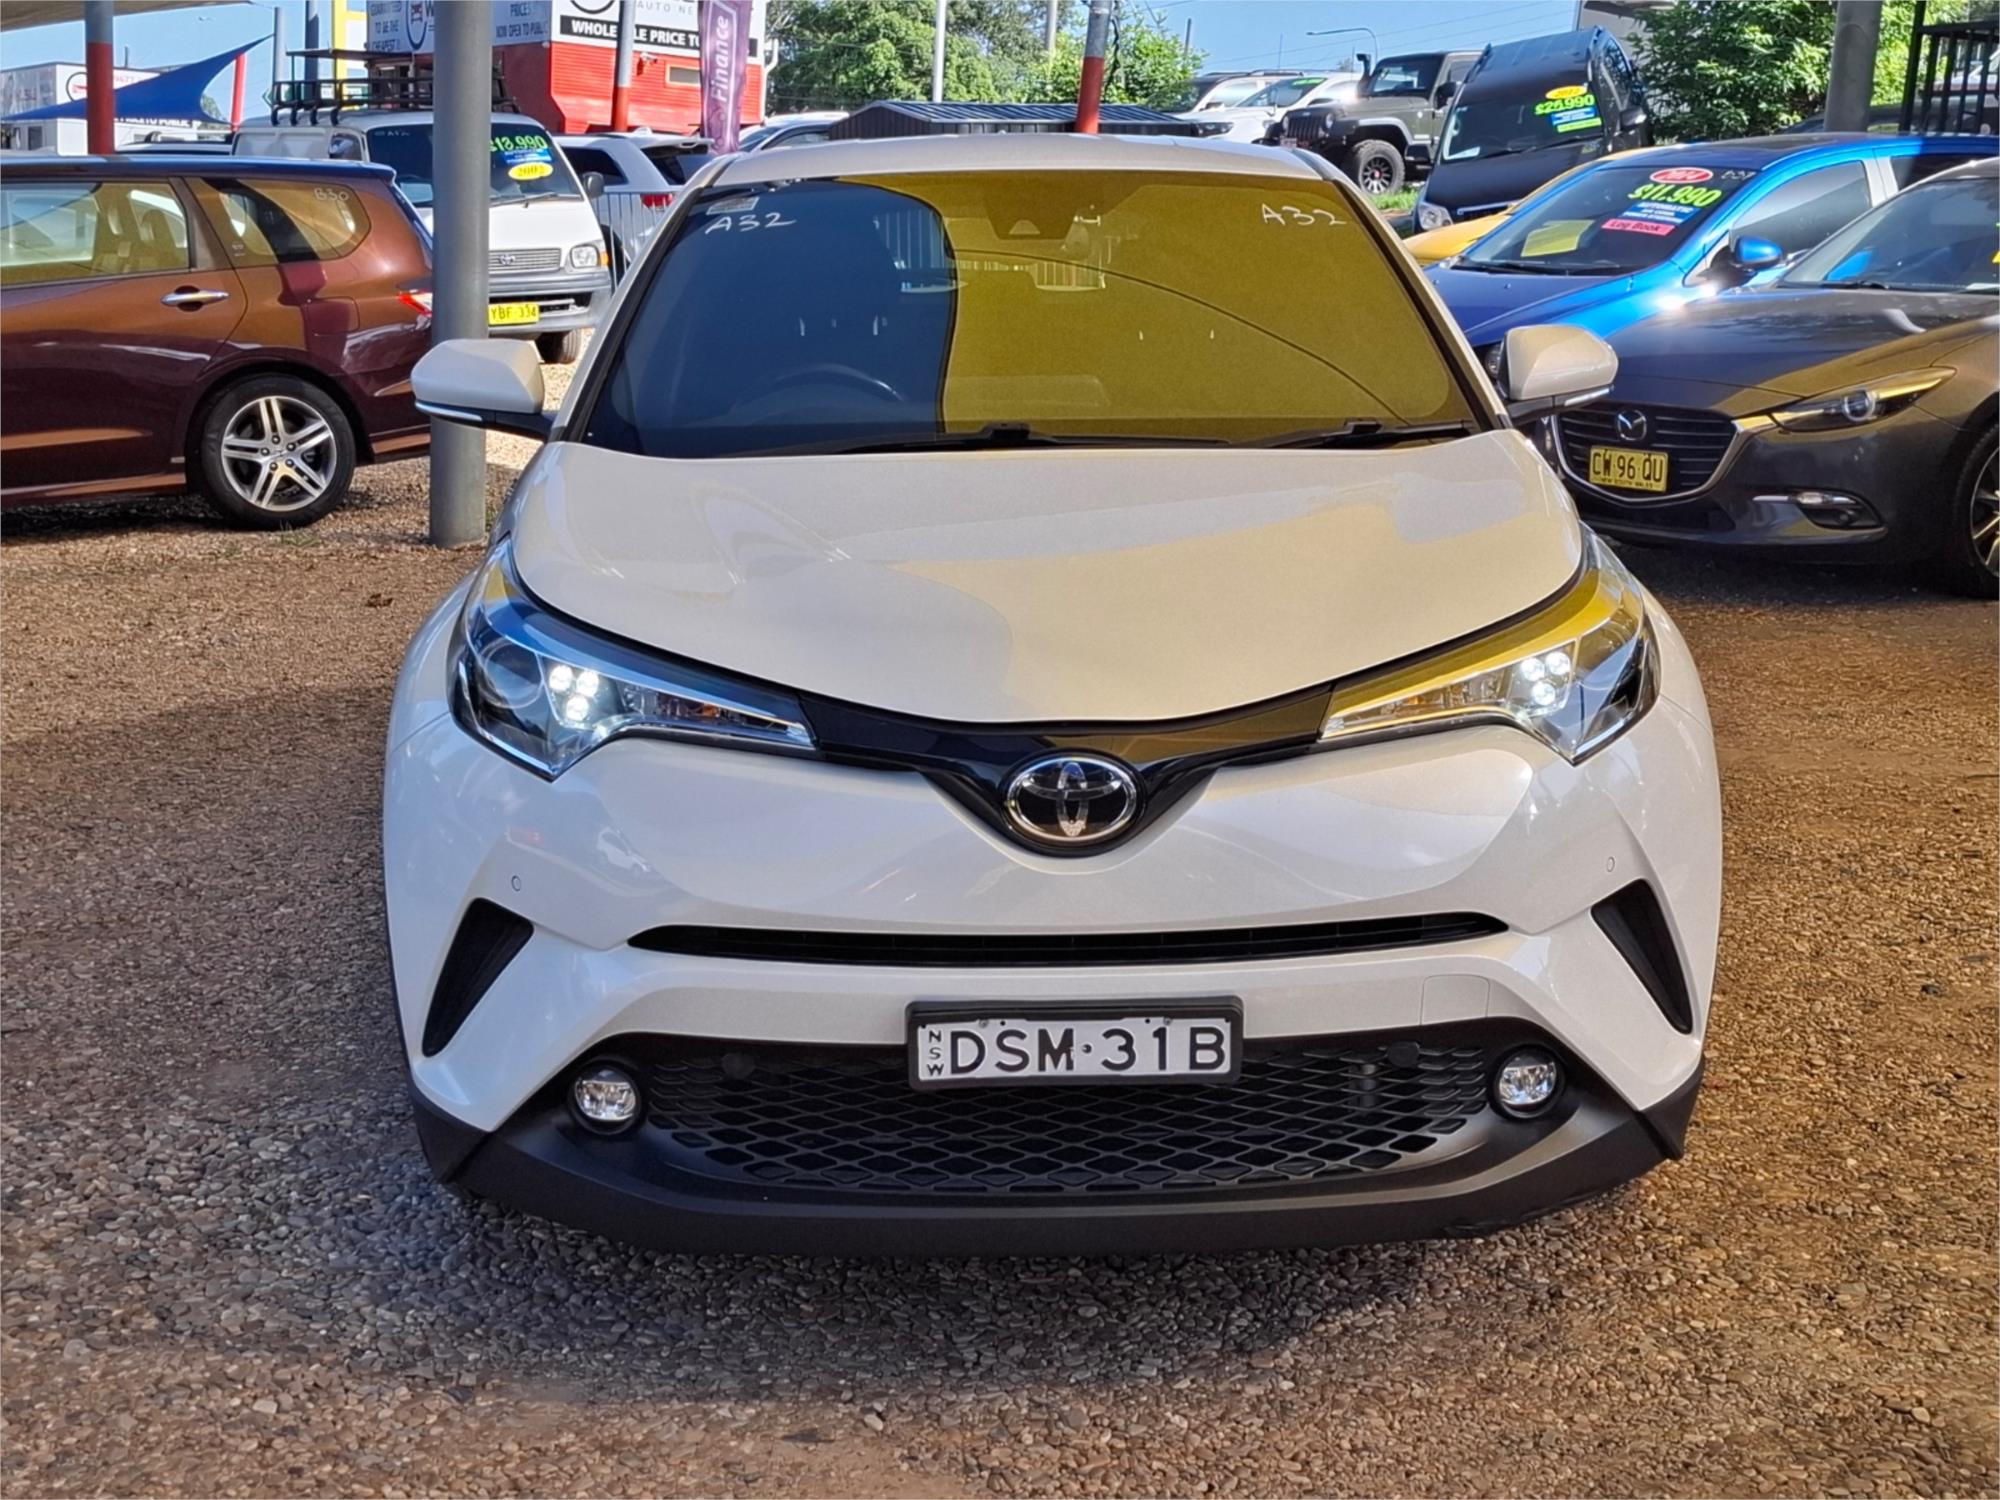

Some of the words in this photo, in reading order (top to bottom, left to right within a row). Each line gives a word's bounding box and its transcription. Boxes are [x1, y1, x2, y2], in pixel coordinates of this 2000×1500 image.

[637, 3, 671, 13] AUTO
[508, 24, 522, 37] OPEN
[523, 25, 530, 36] TO
[571, 19, 646, 42] WHOLELE
[650, 31, 686, 45] PRICE
[711, 15, 730, 103] Finance
[705, 212, 797, 234] A32
[1261, 203, 1347, 226] A32
[926, 1030, 945, 1077] NSW
